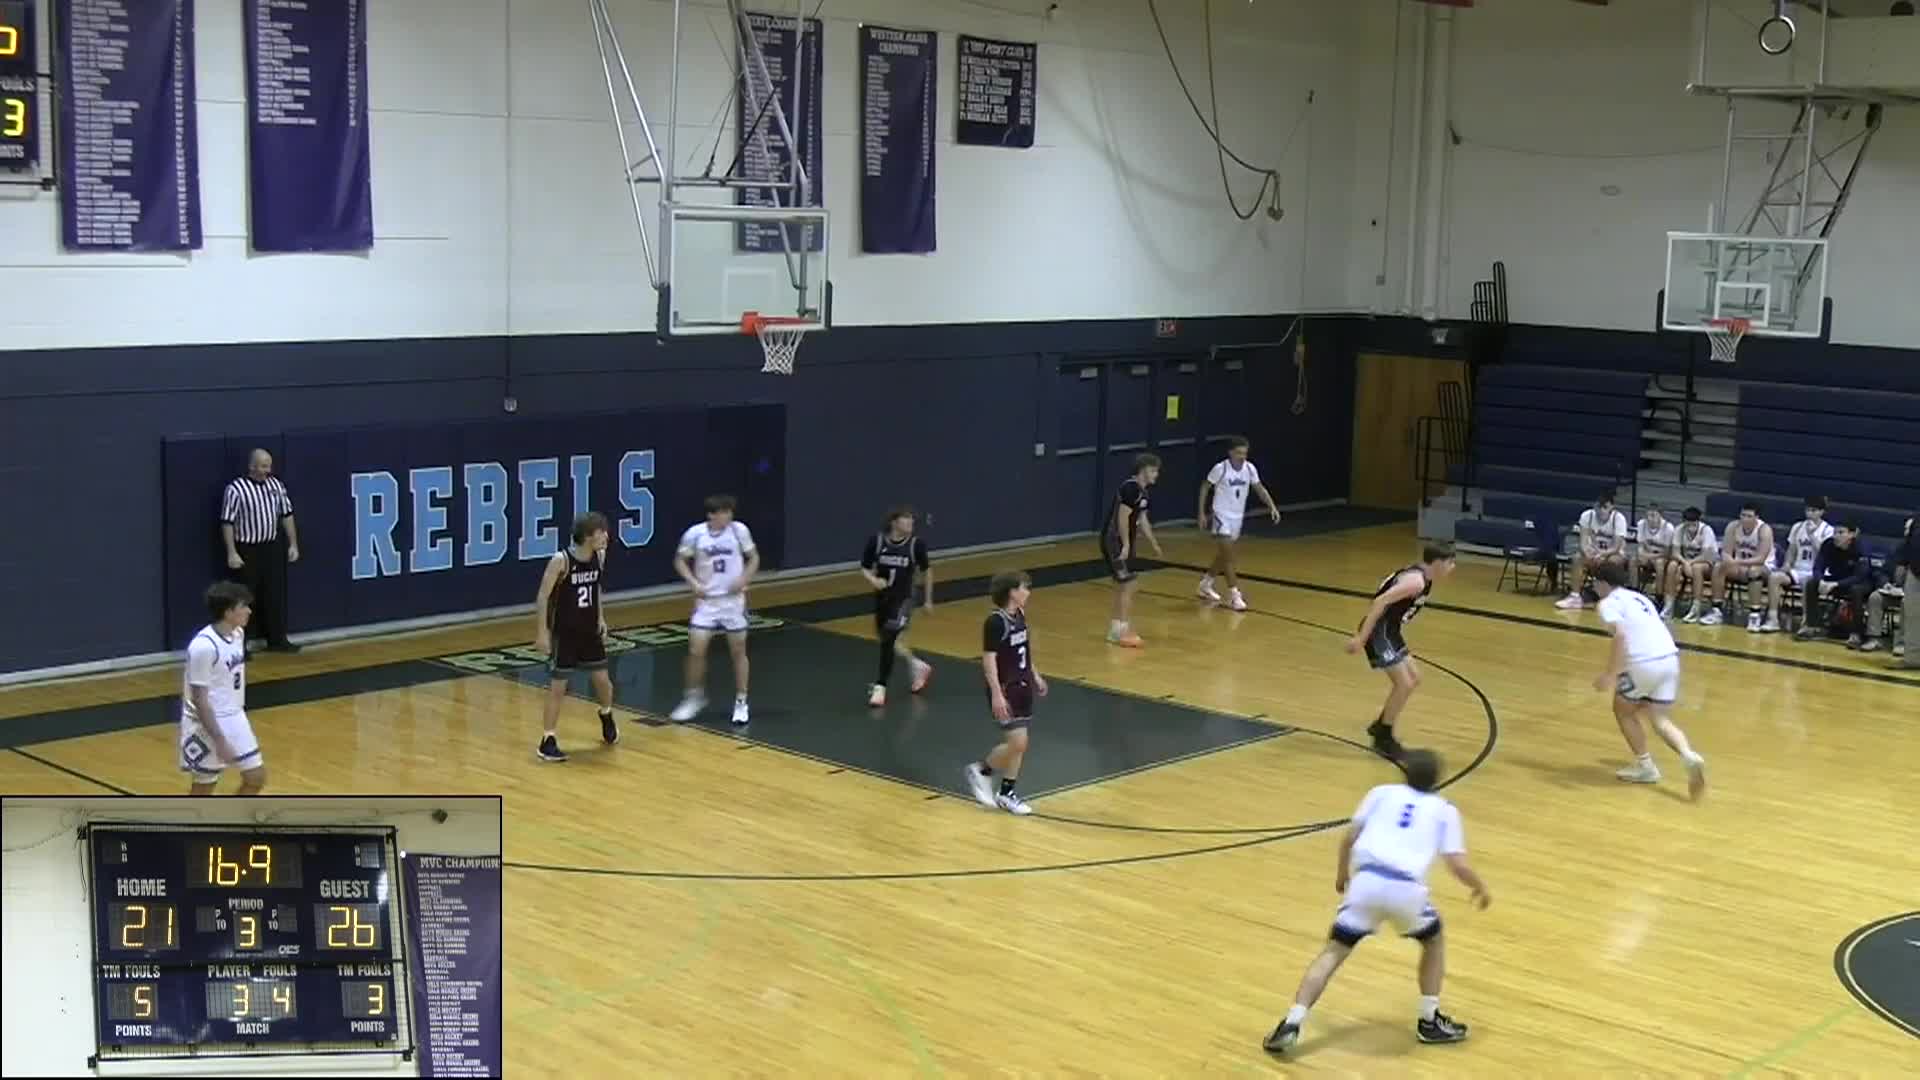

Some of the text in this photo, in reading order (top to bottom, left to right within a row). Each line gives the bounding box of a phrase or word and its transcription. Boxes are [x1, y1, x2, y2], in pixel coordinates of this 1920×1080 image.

[3, 99, 25, 136] 3
[577, 585, 593, 608] 21
[208, 845, 271, 885] 16.9
[420, 856, 501, 869] MVC CHAMPION
[116, 877, 167, 897] HOME
[319, 879, 370, 898] GUEST
[228, 897, 264, 910] PERIOD
[122, 905, 174, 947] 21
[239, 916, 256, 947] 3
[328, 905, 375, 947] 26
[102, 964, 161, 979] TM FOULS
[207, 963, 298, 979] PLAYER FOULS
[337, 963, 392, 977] TM FOULS
[134, 985, 151, 1017] 5
[233, 984, 290, 1017] 3 4
[367, 983, 384, 1015] 3
[115, 1024, 152, 1037] POINTS
[236, 1023, 270, 1035] MATCH
[350, 1020, 386, 1033] POINTS
